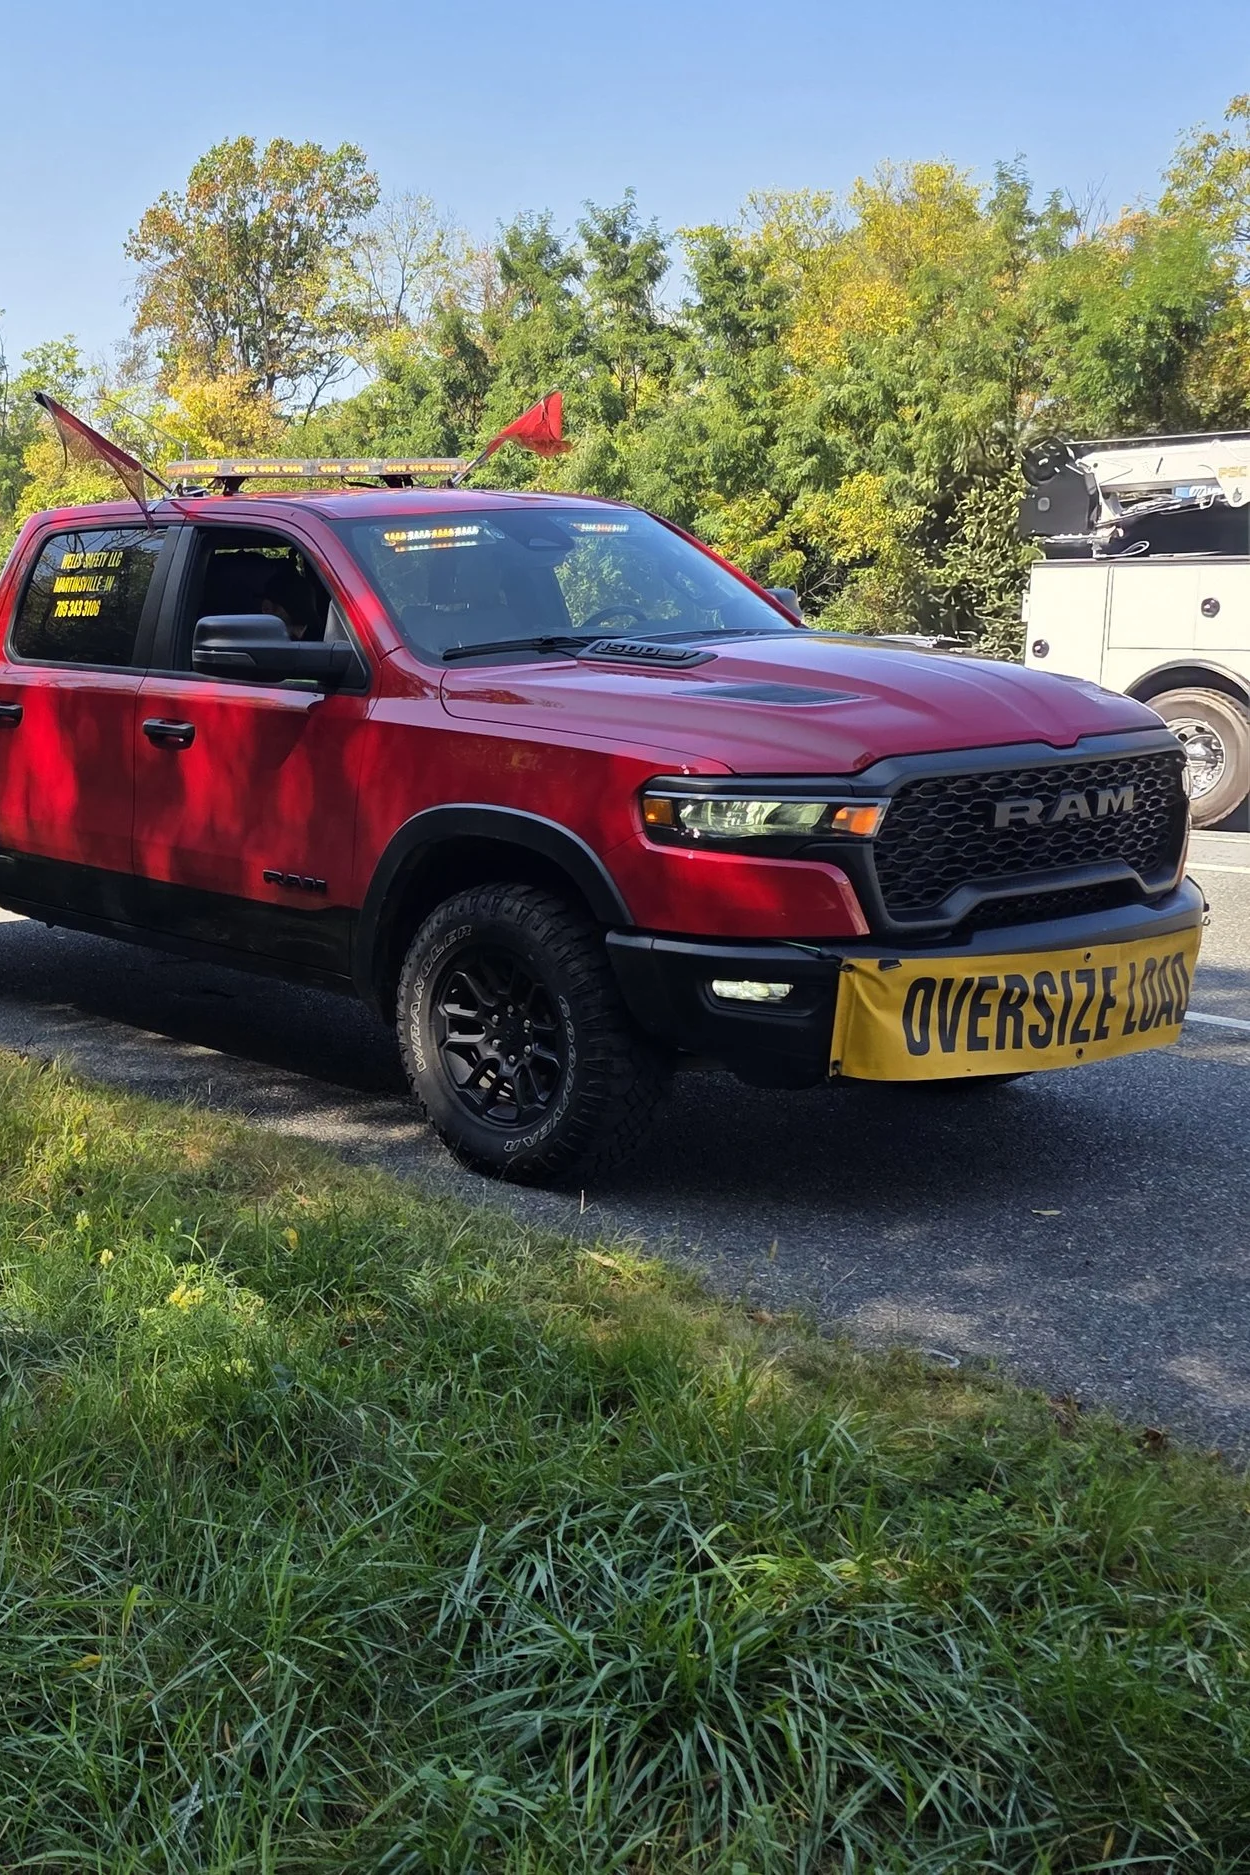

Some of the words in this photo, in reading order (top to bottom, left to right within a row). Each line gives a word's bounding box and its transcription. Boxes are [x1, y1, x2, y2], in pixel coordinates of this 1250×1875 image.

[83, 552, 109, 568] SAFETY
[108, 551, 123, 567] LLC
[596, 640, 663, 656] 1500
[994, 786, 1134, 828] RAM
[263, 869, 327, 894] RAM
[410, 924, 472, 1073] WRANGLER
[902, 965, 1118, 1057] OVERSIZE
[1121, 952, 1190, 1036] LOAD
